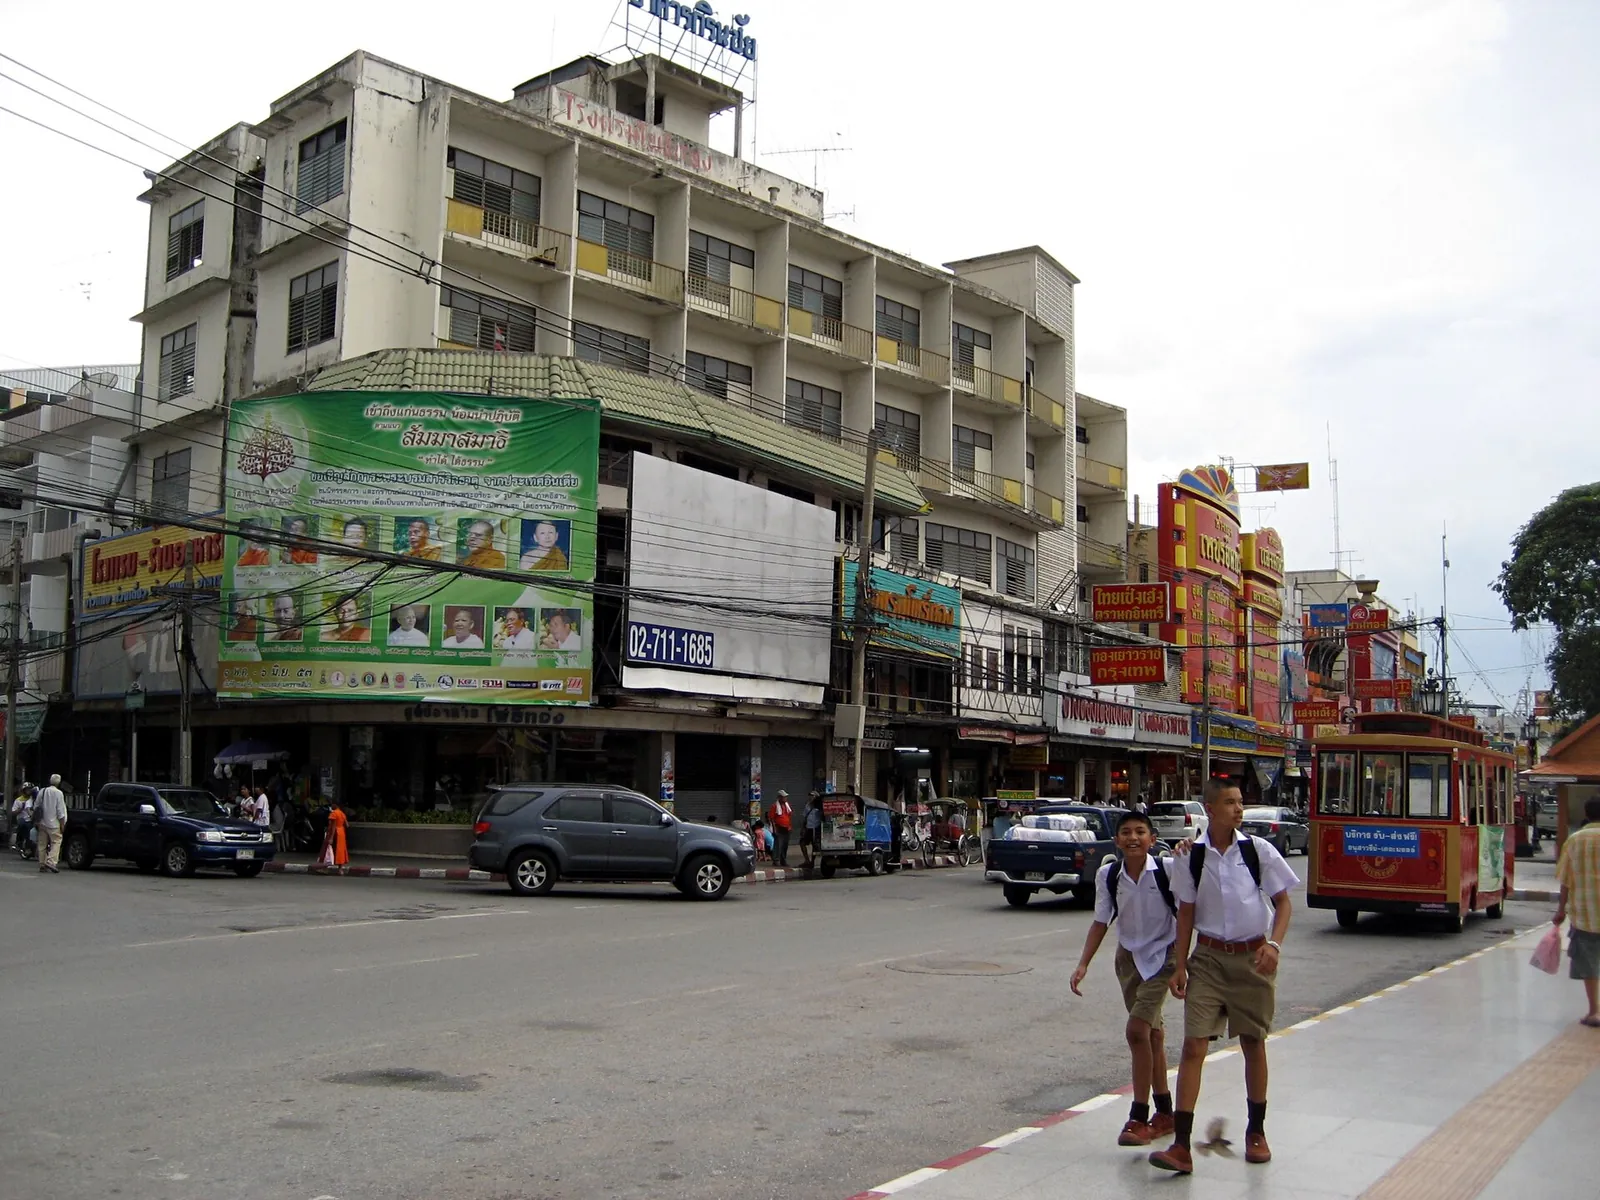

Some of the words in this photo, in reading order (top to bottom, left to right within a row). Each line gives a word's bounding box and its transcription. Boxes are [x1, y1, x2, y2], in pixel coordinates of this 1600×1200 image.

[402, 425, 511, 449] สัมมาสมาธิ
[483, 474, 579, 489] จากประเทศอินเดีย
[629, 625, 713, 666] 02-711-1685
[1097, 666, 1157, 681] กรุงเทพ
[1345, 829, 1371, 839] บริการ
